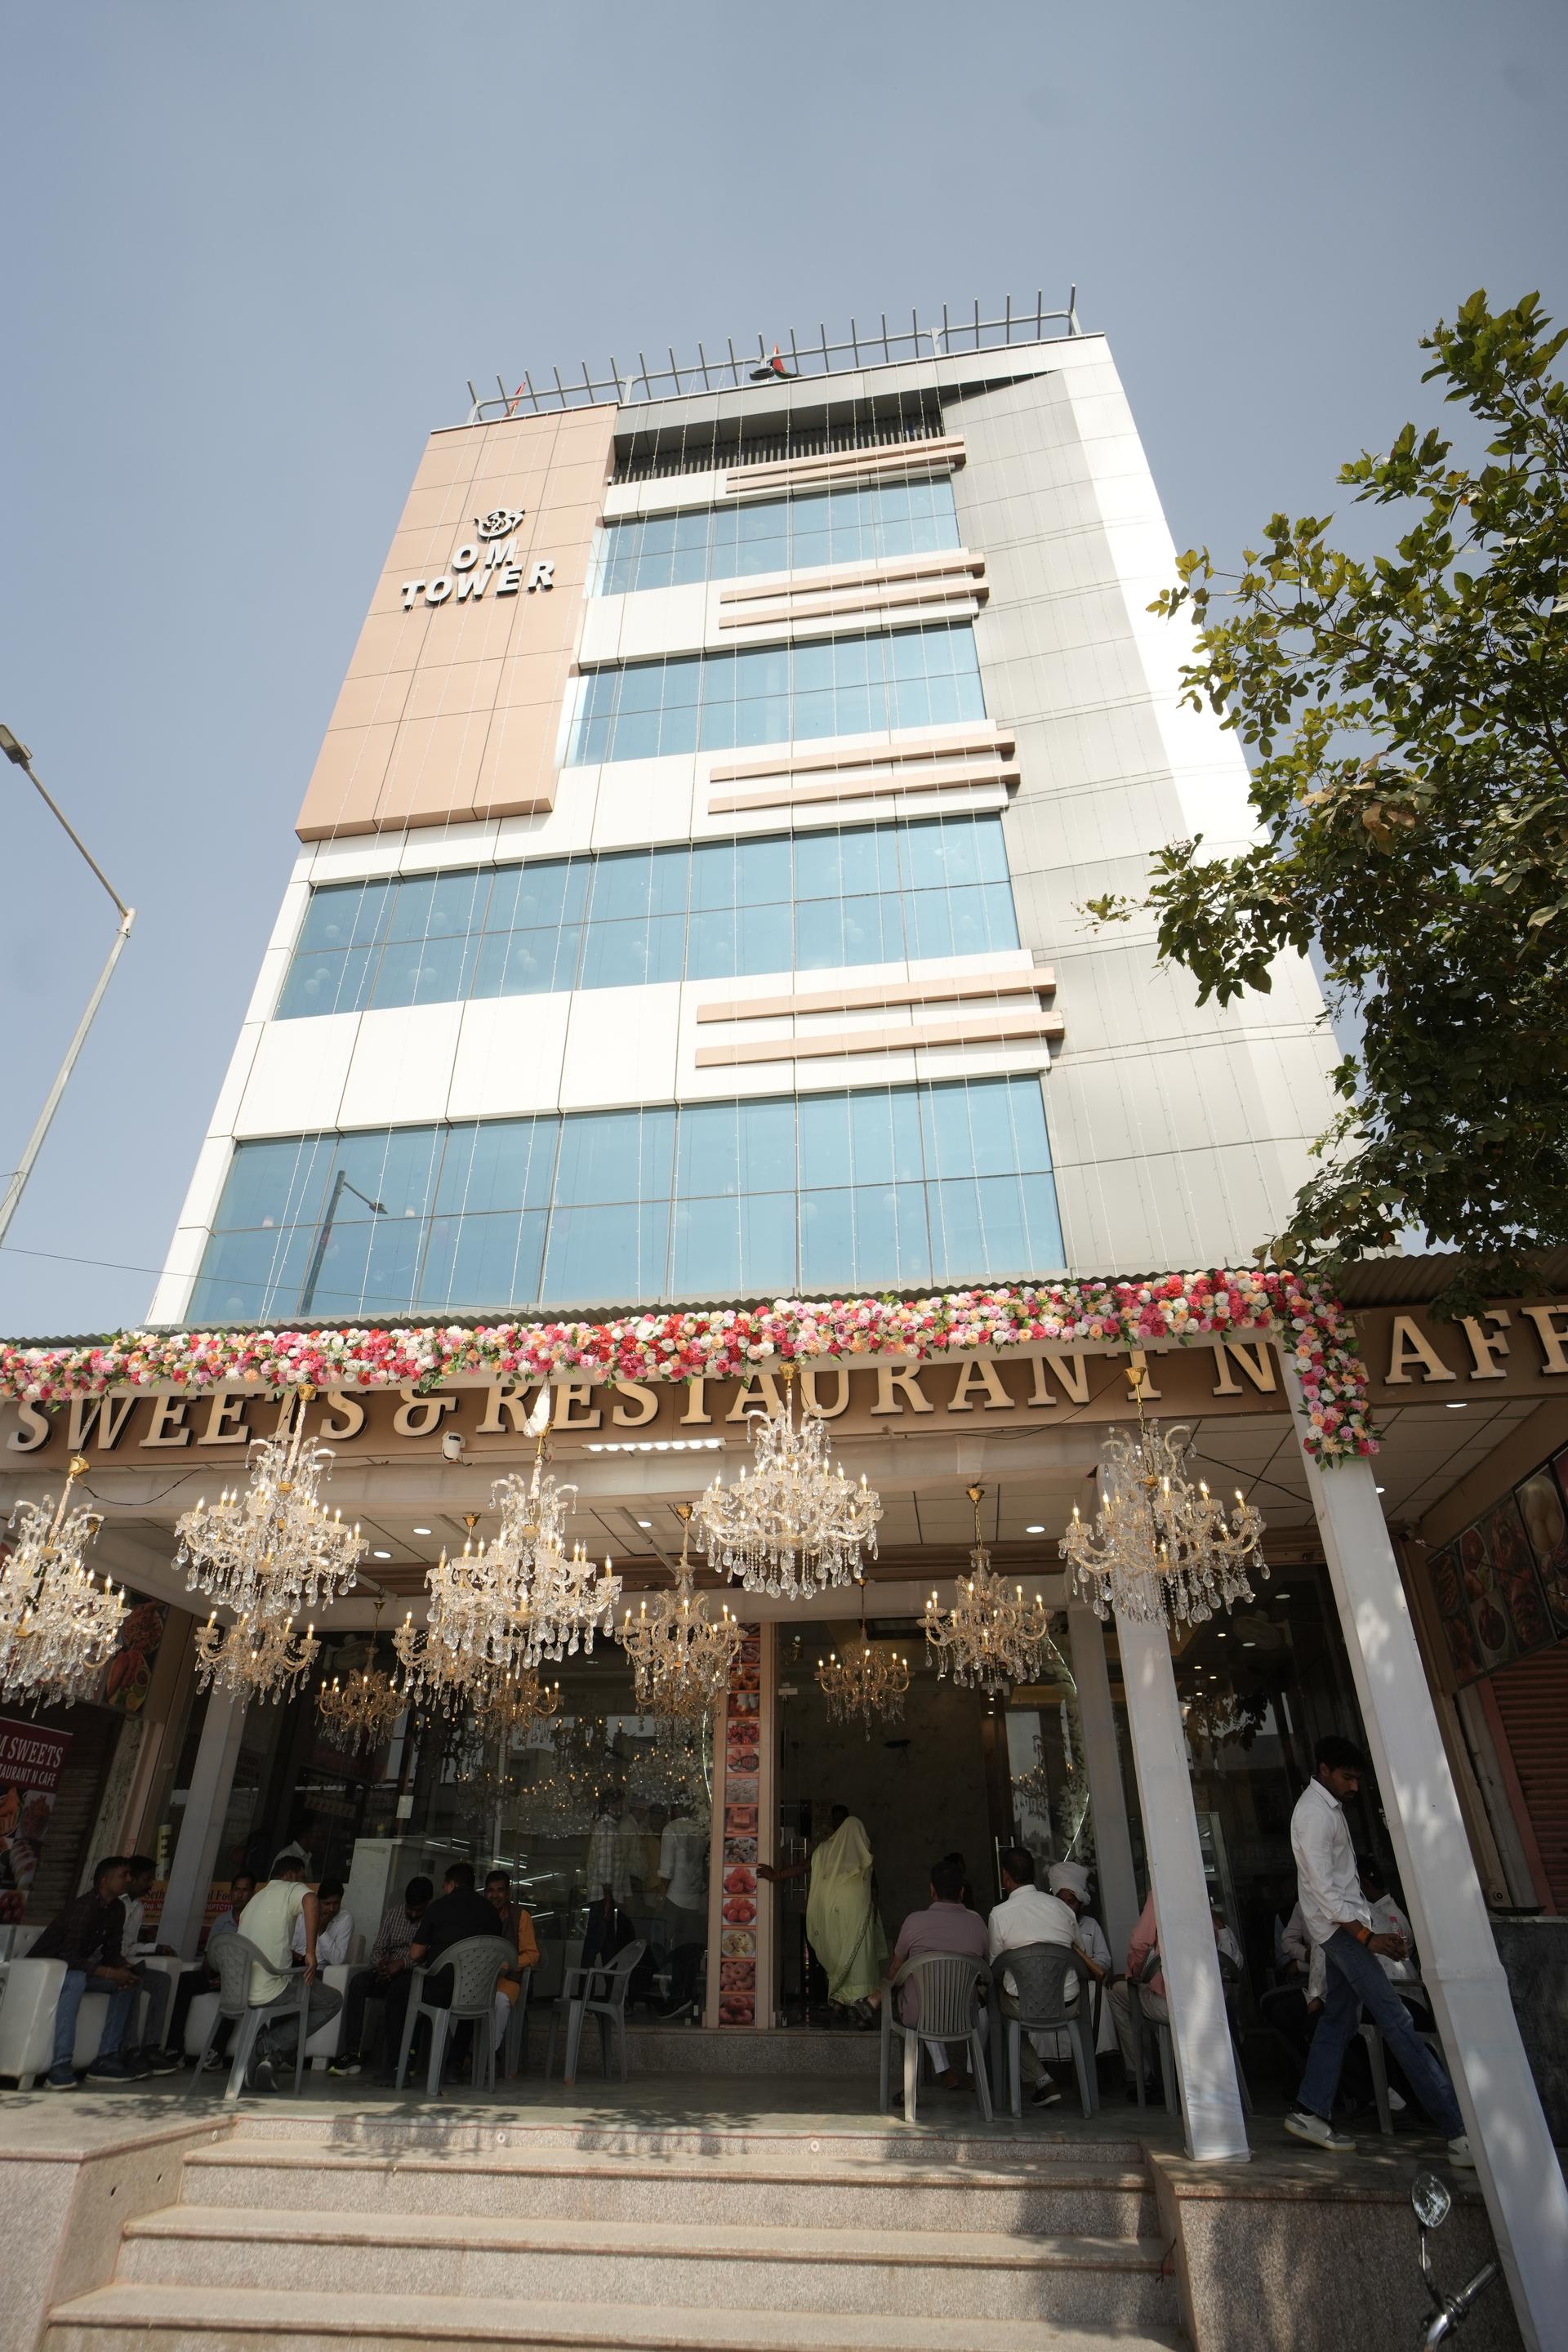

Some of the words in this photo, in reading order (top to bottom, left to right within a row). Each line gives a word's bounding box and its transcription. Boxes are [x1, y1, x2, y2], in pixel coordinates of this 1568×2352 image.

[452, 537, 519, 571] OM
[401, 559, 555, 609] TOWER
[6, 1389, 368, 1451] SWEETS
[393, 1388, 457, 1437] &
[475, 1348, 1162, 1433] RESTAURANT
[7, 1737, 64, 1768] SWEETS
[38, 1771, 56, 1787] CAFE
